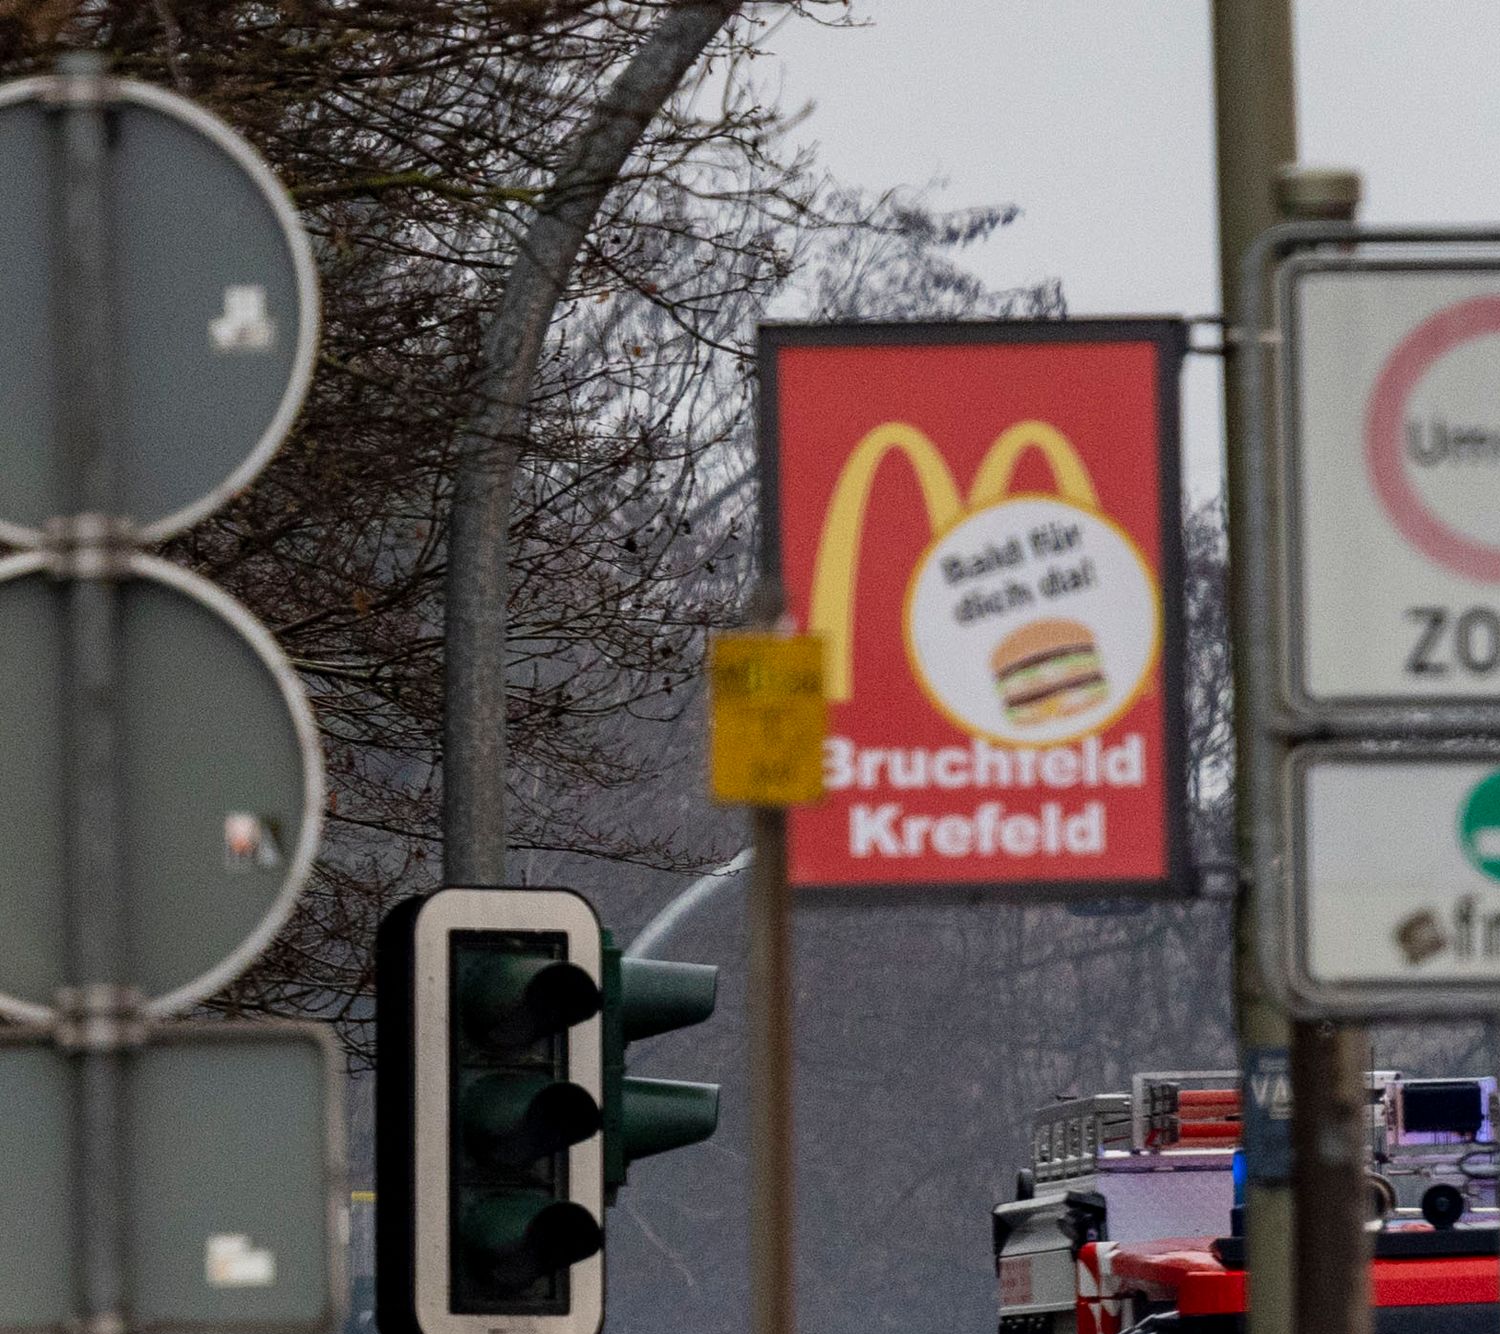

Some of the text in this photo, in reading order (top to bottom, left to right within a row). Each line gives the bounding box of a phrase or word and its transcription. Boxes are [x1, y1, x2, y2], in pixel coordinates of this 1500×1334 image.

[940, 521, 1082, 585] Bald für
[955, 558, 1097, 625] dich da!
[822, 734, 1146, 790] Bruchfeld
[850, 801, 1106, 857] Krefeld
